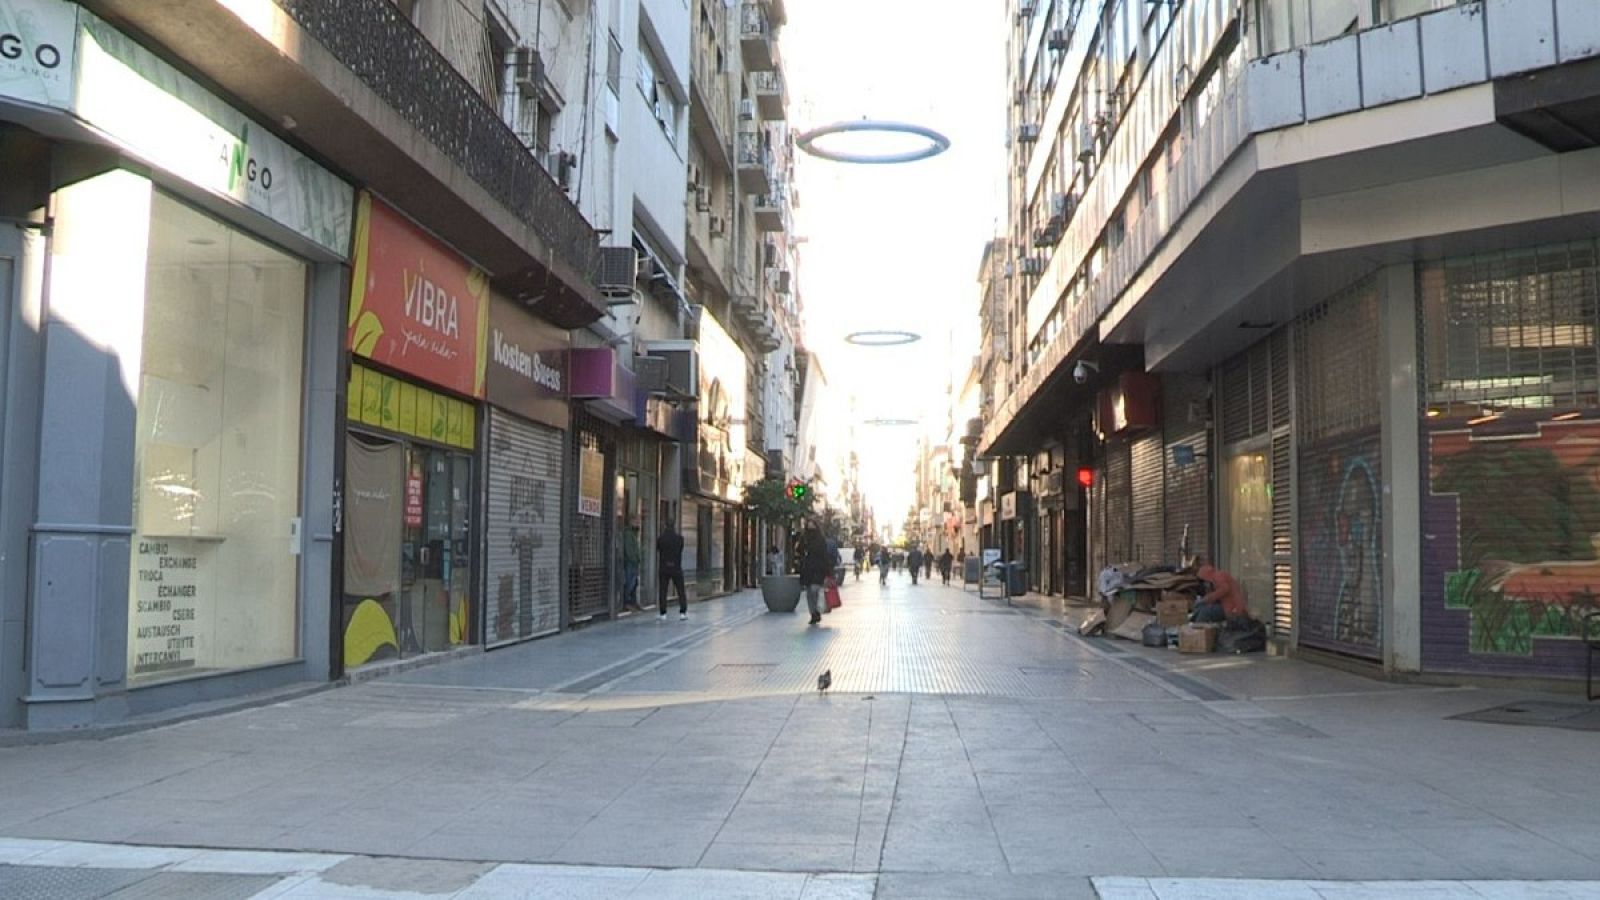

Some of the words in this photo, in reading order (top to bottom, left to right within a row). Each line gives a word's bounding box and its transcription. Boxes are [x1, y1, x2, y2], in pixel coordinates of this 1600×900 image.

[403, 262, 458, 340] VIBRA
[493, 329, 532, 378] Kosten
[139, 542, 168, 555] CAMBIO
[159, 556, 197, 569] EXCHANGE
[139, 569, 163, 582] TROCA
[137, 599, 171, 613] SCAMBIO
[136, 624, 181, 639] AUSTAUSCH
